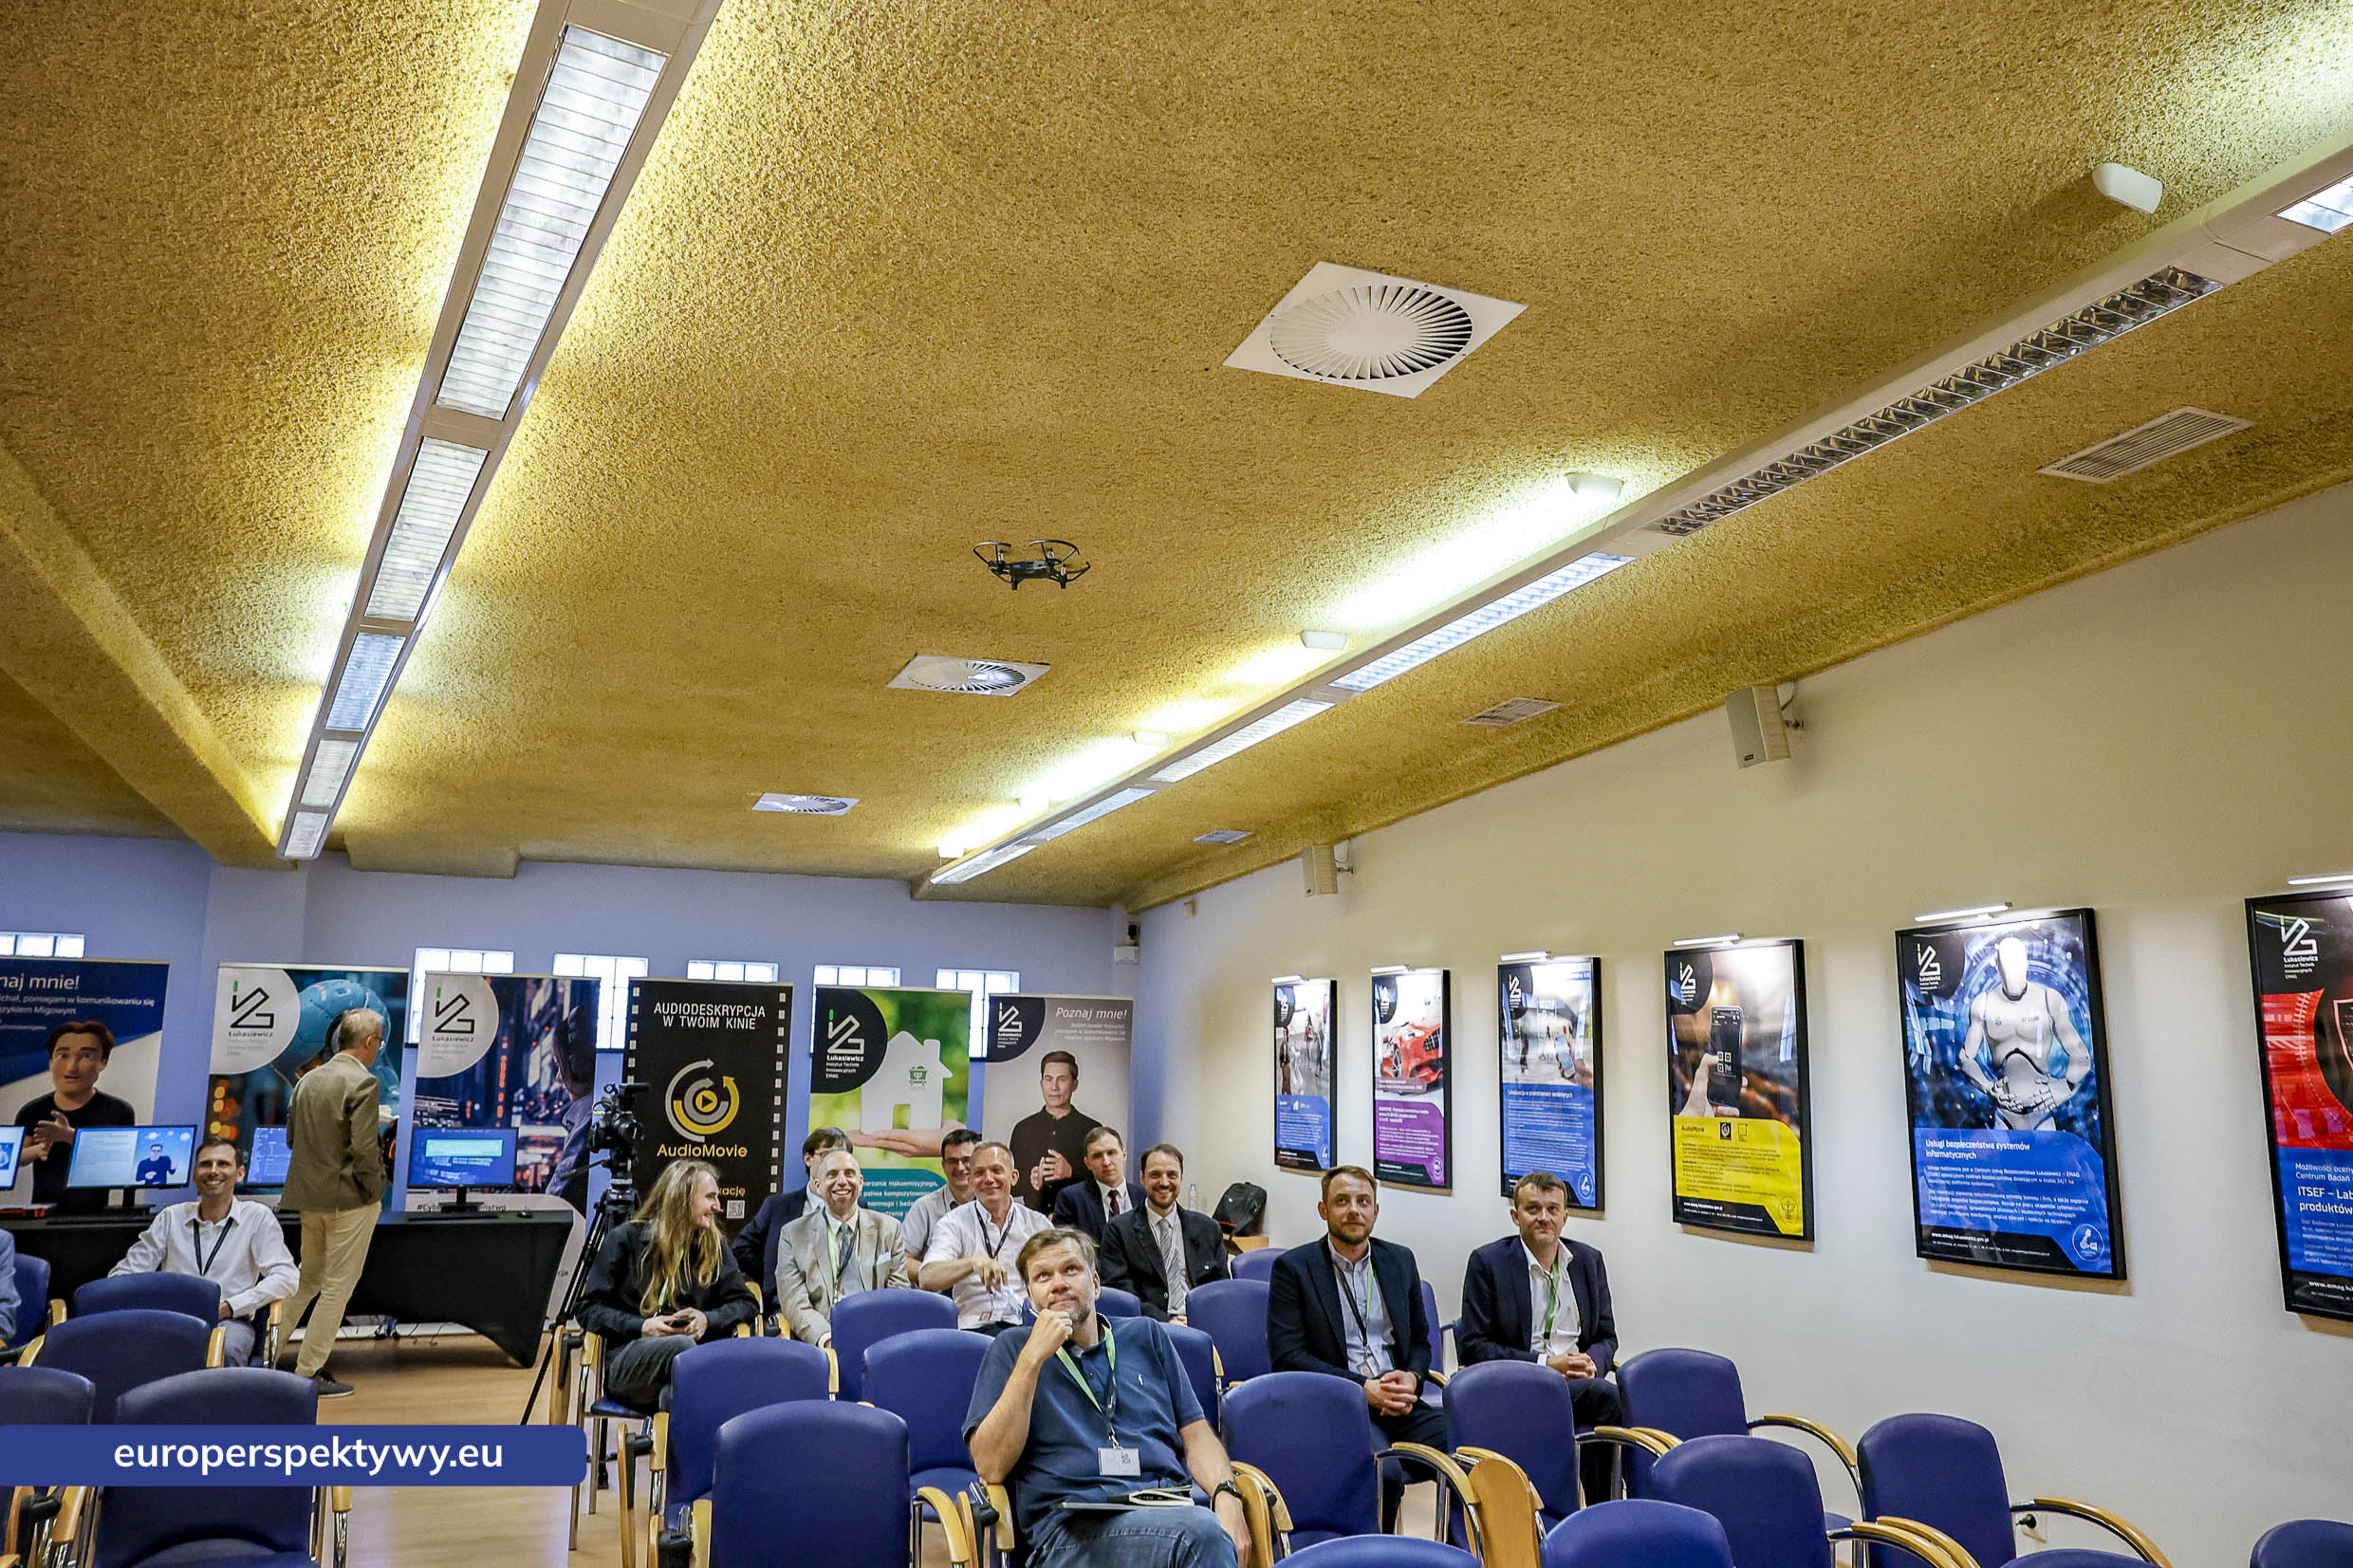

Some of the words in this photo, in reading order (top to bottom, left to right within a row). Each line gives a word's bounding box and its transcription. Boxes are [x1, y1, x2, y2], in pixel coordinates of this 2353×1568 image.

[29, 974, 80, 989] mnie!
[76, 996, 141, 1005] komunikowaniu
[654, 1002, 766, 1017] AUDIODESKRYPCJA
[1056, 1007, 1092, 1020] Poznaj
[1096, 1009, 1127, 1020] mnie!
[663, 1015, 674, 1027] W
[679, 1016, 719, 1028] TWOIM
[726, 1018, 756, 1029] KINIE
[657, 1144, 748, 1157] AudioMovie
[1995, 1141, 2029, 1152] systemów
[2296, 1171, 2325, 1180] Centrum
[2327, 1173, 2350, 1182] Badań
[2298, 1186, 2325, 1197] ITSEF
[2299, 1202, 2353, 1214] produktów
